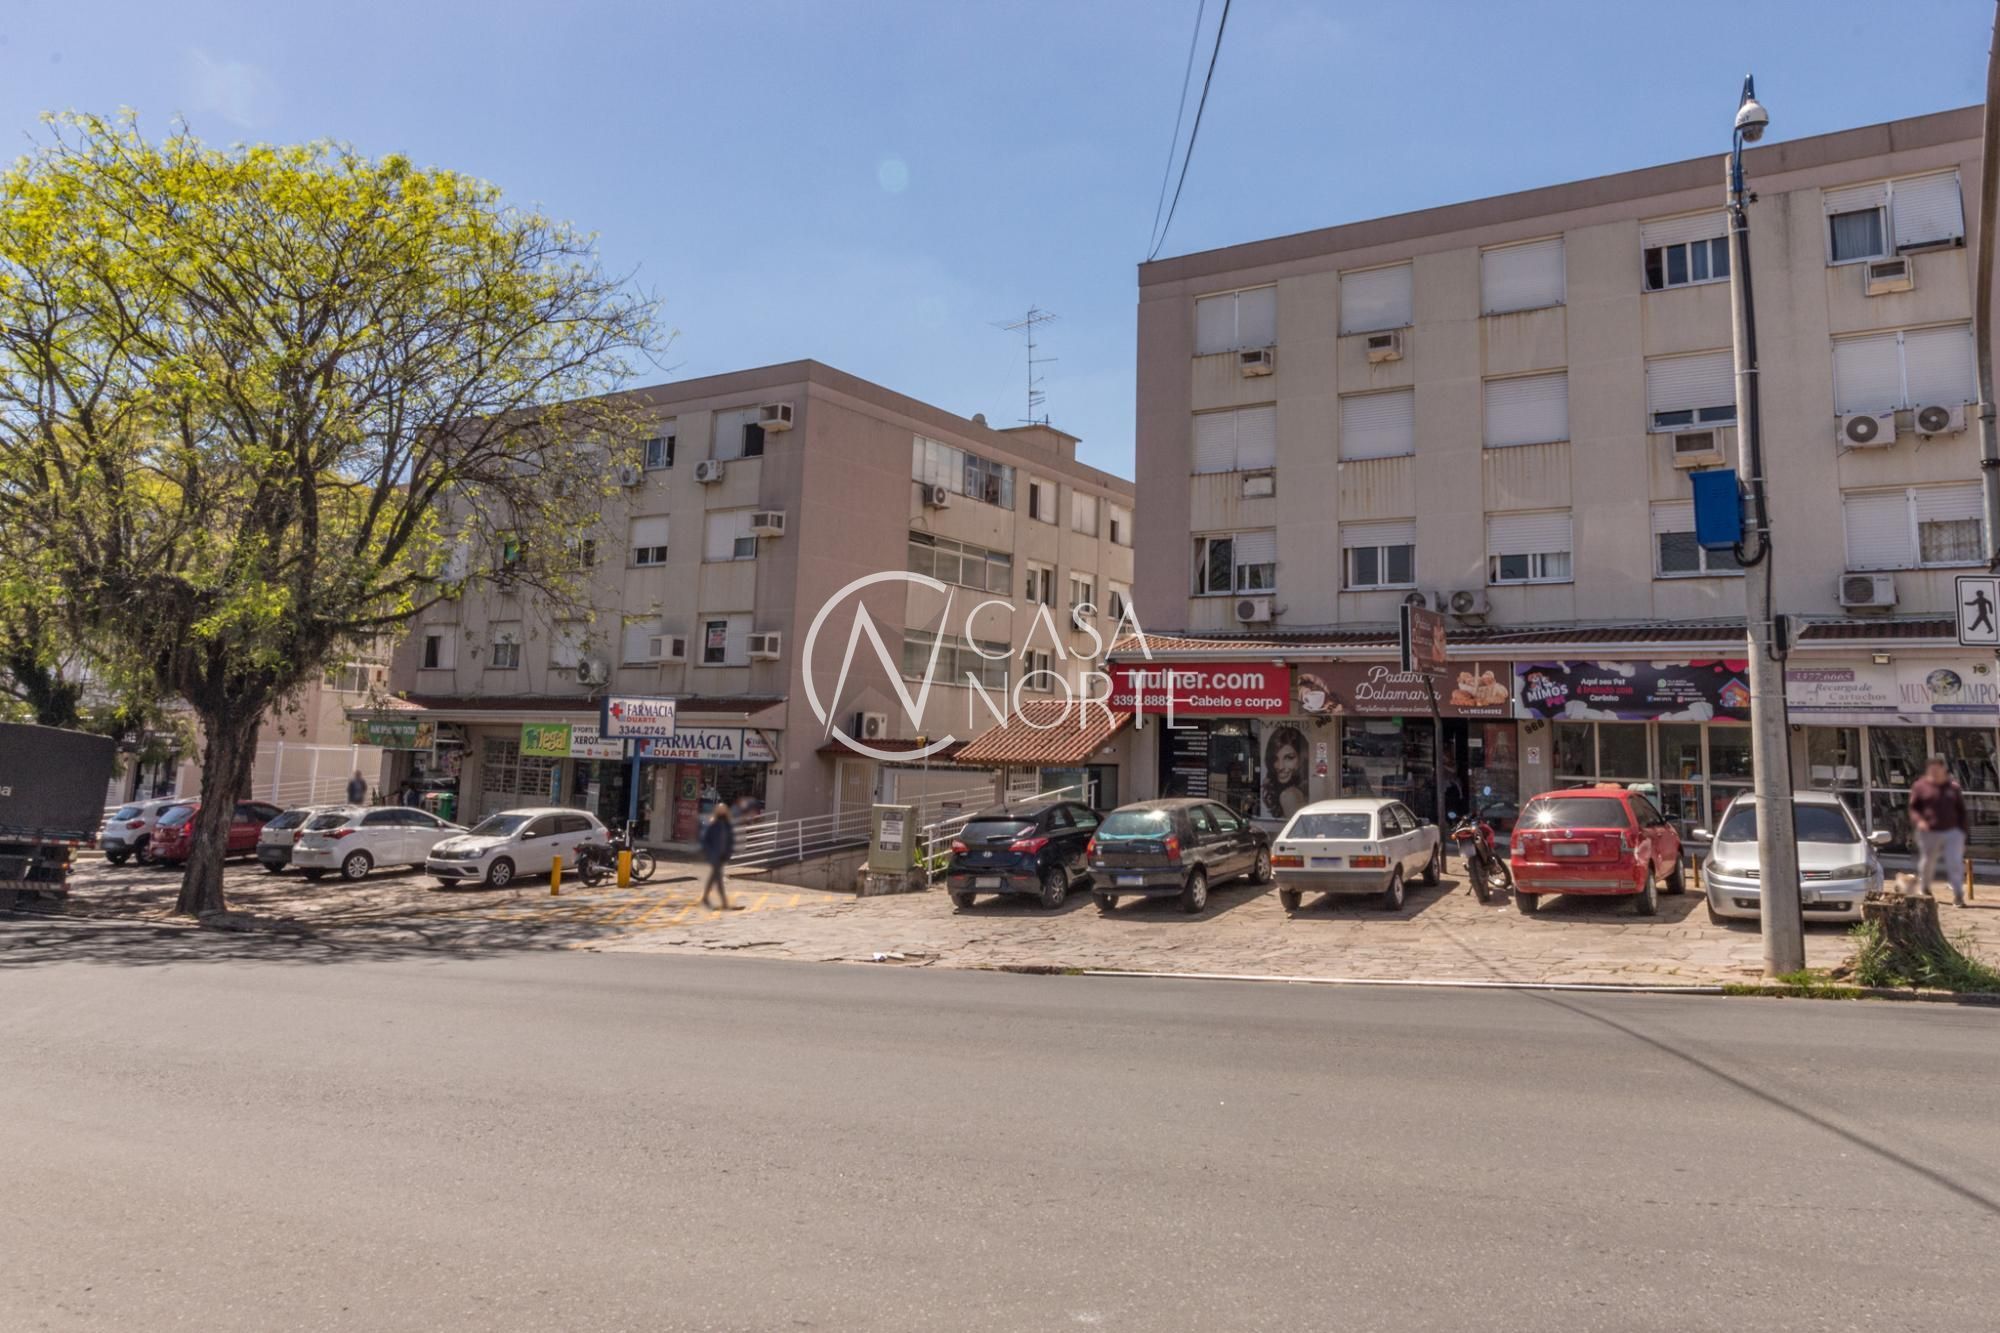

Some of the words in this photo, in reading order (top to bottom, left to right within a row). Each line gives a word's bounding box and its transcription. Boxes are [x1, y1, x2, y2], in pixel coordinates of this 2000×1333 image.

[1368, 665, 1434, 683] Padari
[1526, 684, 1568, 702] MIMOS
[627, 701, 674, 718] FARMÁCIA
[1189, 695, 1232, 707] Cabelo
[1234, 698, 1242, 706] e
[1245, 698, 1282, 709] corpo
[618, 725, 666, 736] 3344.2742
[574, 736, 599, 745] XEROX
